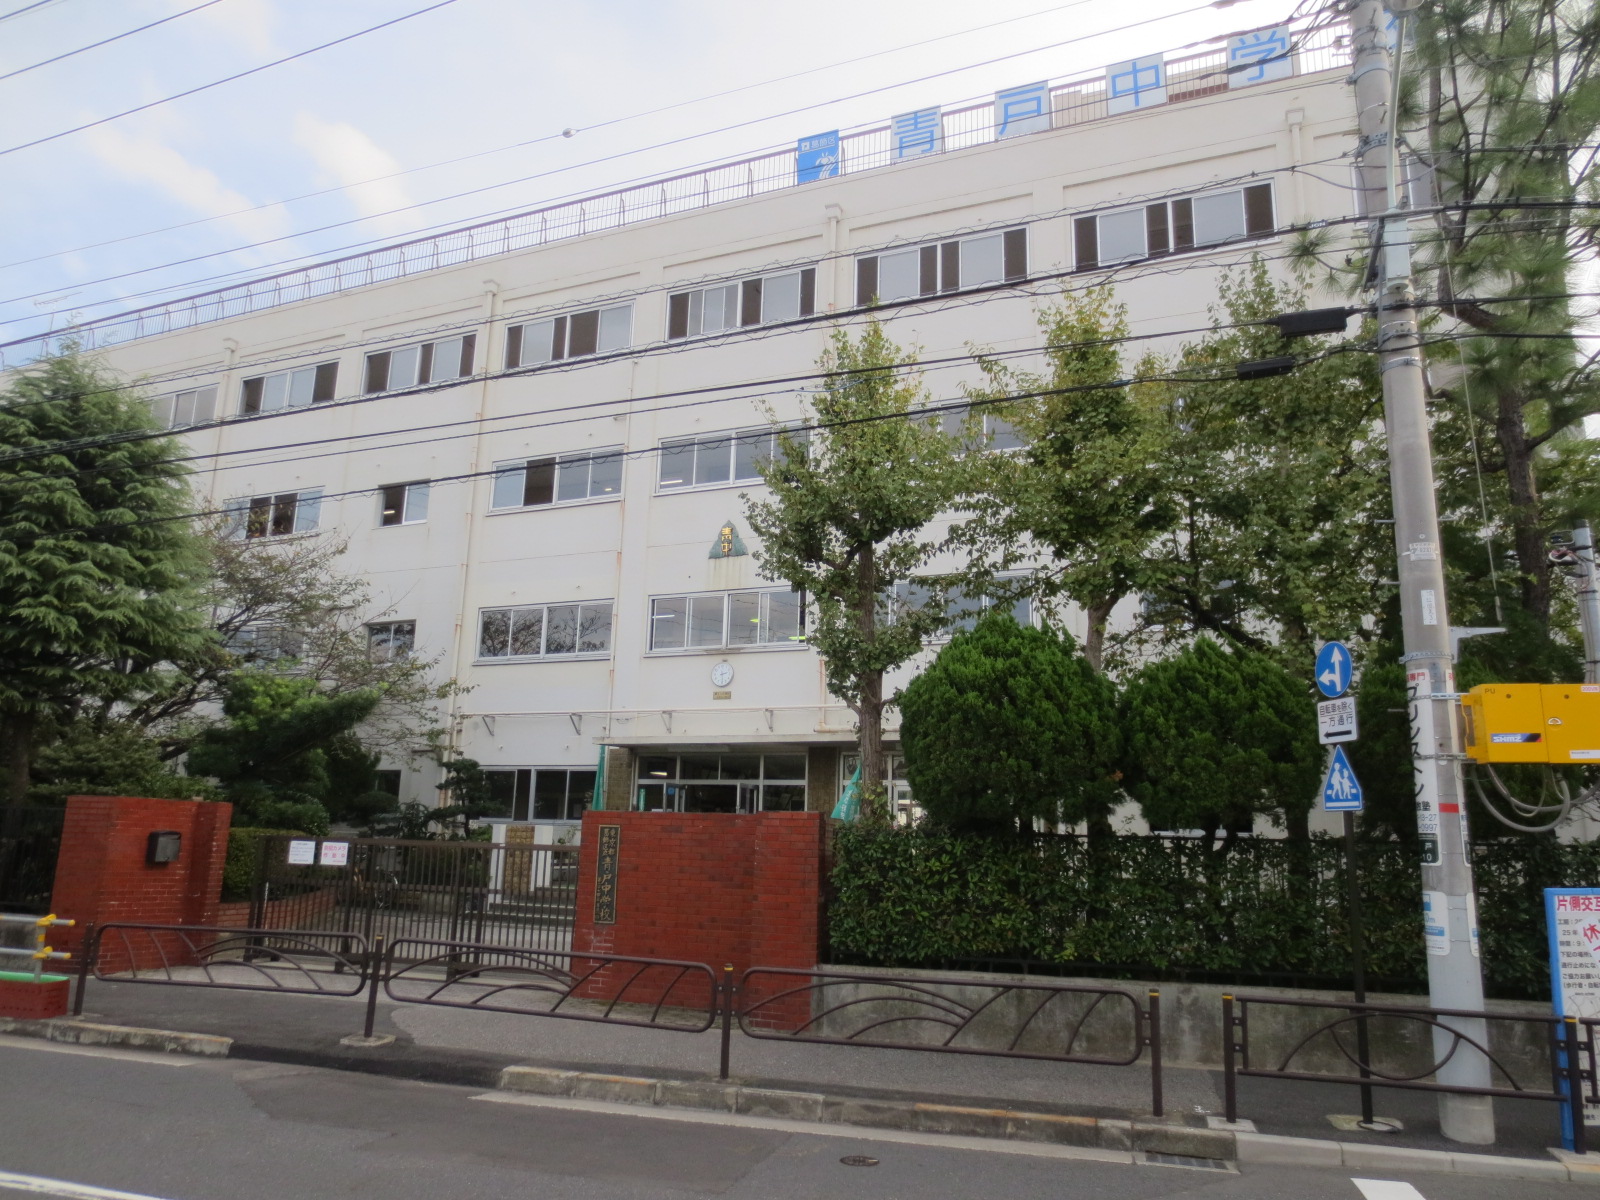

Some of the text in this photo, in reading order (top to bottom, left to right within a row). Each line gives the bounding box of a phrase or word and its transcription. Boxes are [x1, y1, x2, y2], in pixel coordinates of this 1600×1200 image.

[721, 526, 732, 555] 青中
[1320, 701, 1353, 716] 自転車を除く
[1320, 713, 1353, 727] 一方通行
